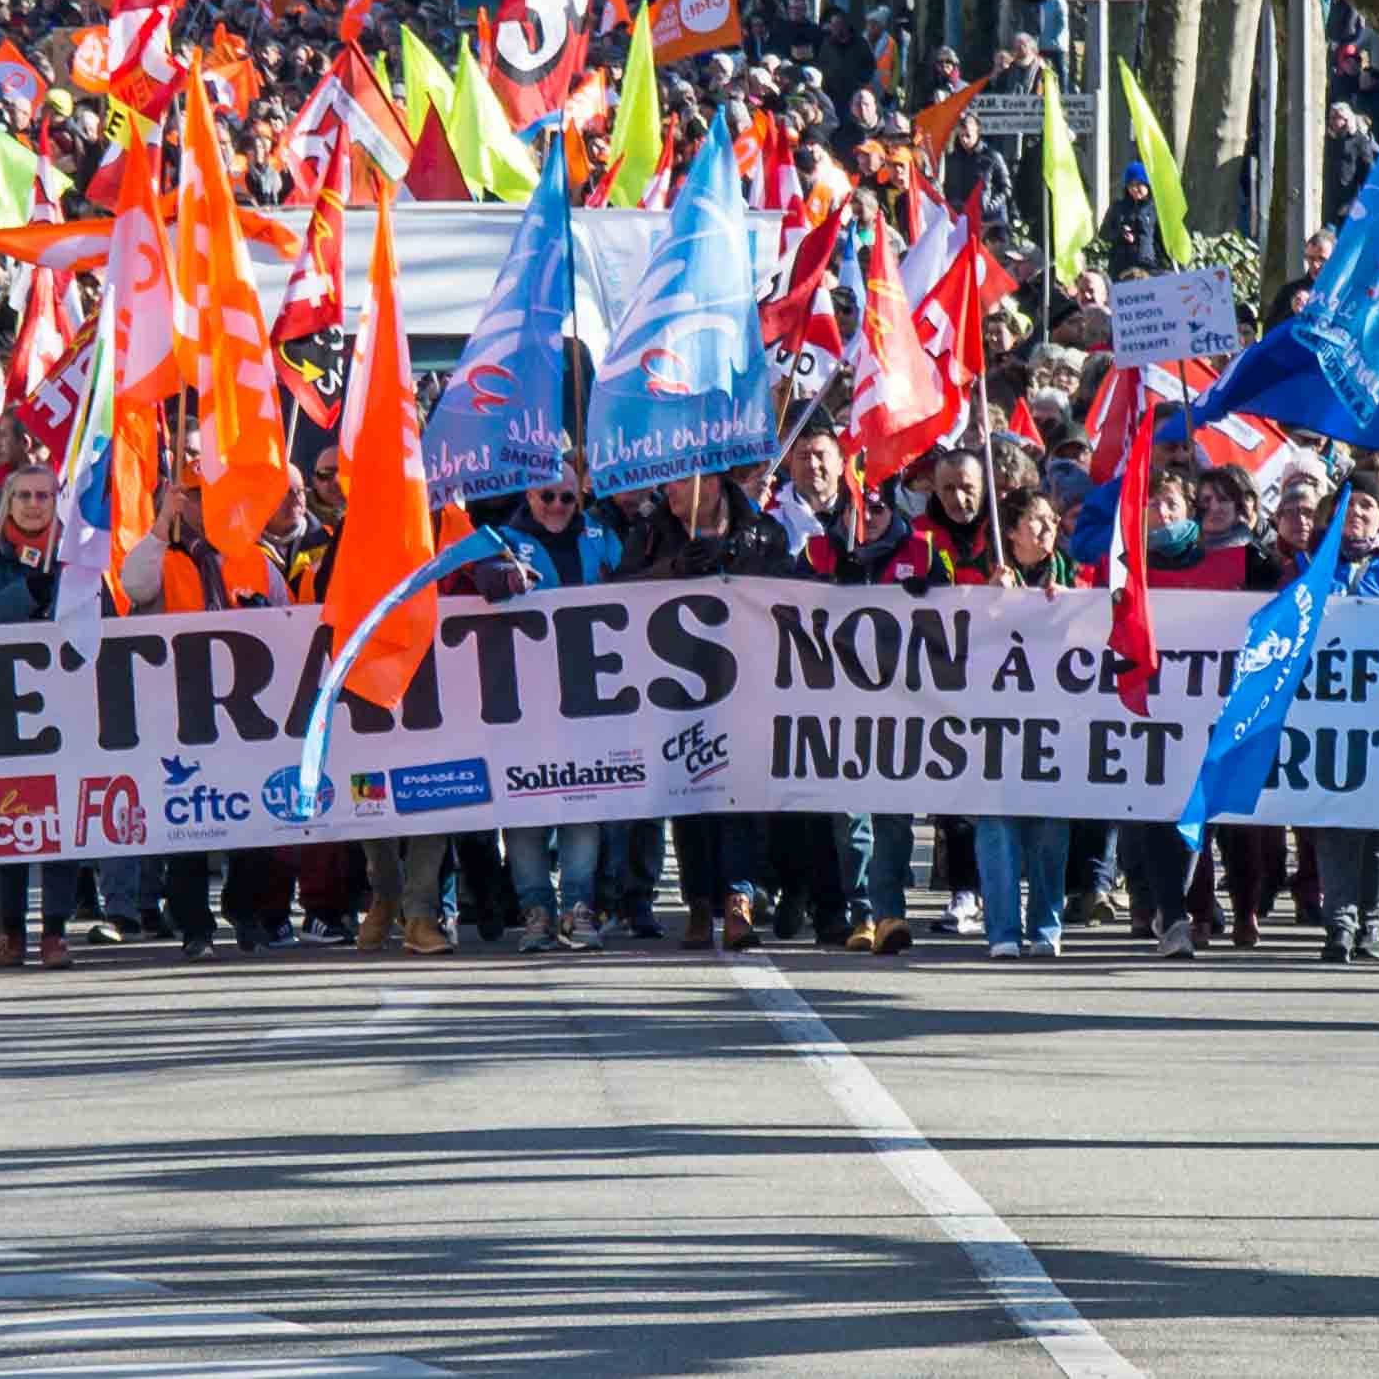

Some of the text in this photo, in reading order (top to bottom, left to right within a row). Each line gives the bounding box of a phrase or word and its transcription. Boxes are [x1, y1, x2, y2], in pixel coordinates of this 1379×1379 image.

[1190, 331, 1235, 354] cftc
[427, 439, 491, 483] ibres
[591, 425, 662, 471] Libres
[596, 474, 623, 492] LA
[624, 457, 688, 486] MARQUE
[770, 604, 971, 692] NON
[991, 630, 1036, 693] À
[662, 719, 705, 762] CFE
[685, 732, 728, 774] CGC
[770, 715, 1061, 782] INJUSTE
[1087, 720, 1183, 786] ET
[505, 759, 646, 792] Solidaires
[74, 774, 141, 847] FO
[164, 785, 252, 825] cftc
